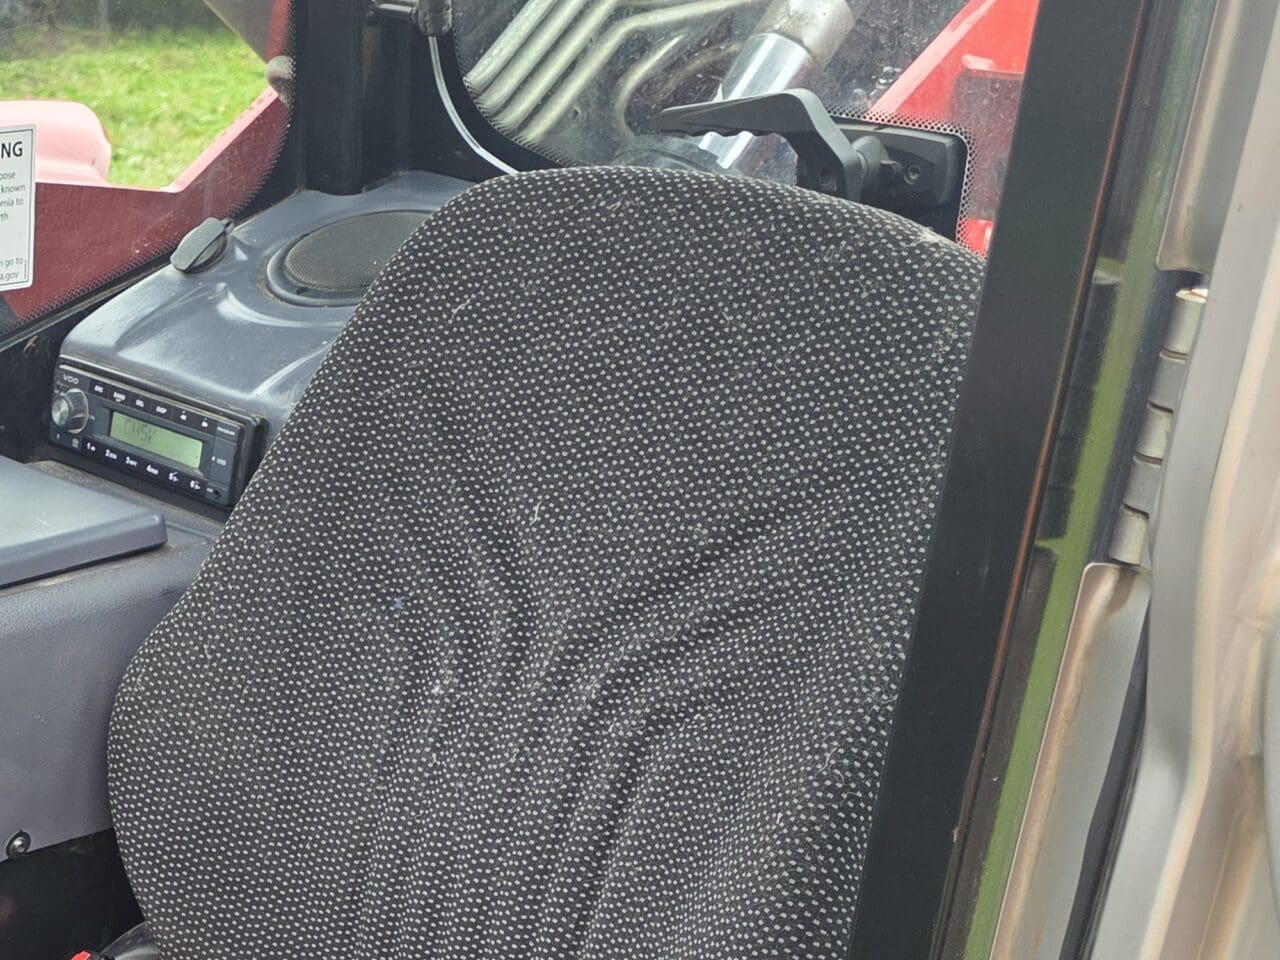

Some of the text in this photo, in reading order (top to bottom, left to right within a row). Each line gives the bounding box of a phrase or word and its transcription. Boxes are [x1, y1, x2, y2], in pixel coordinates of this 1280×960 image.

[1, 183, 25, 194] known
[16, 197, 23, 206] to
[4, 260, 15, 268] go
[16, 257, 23, 265] to
[63, 374, 79, 384] VDO
